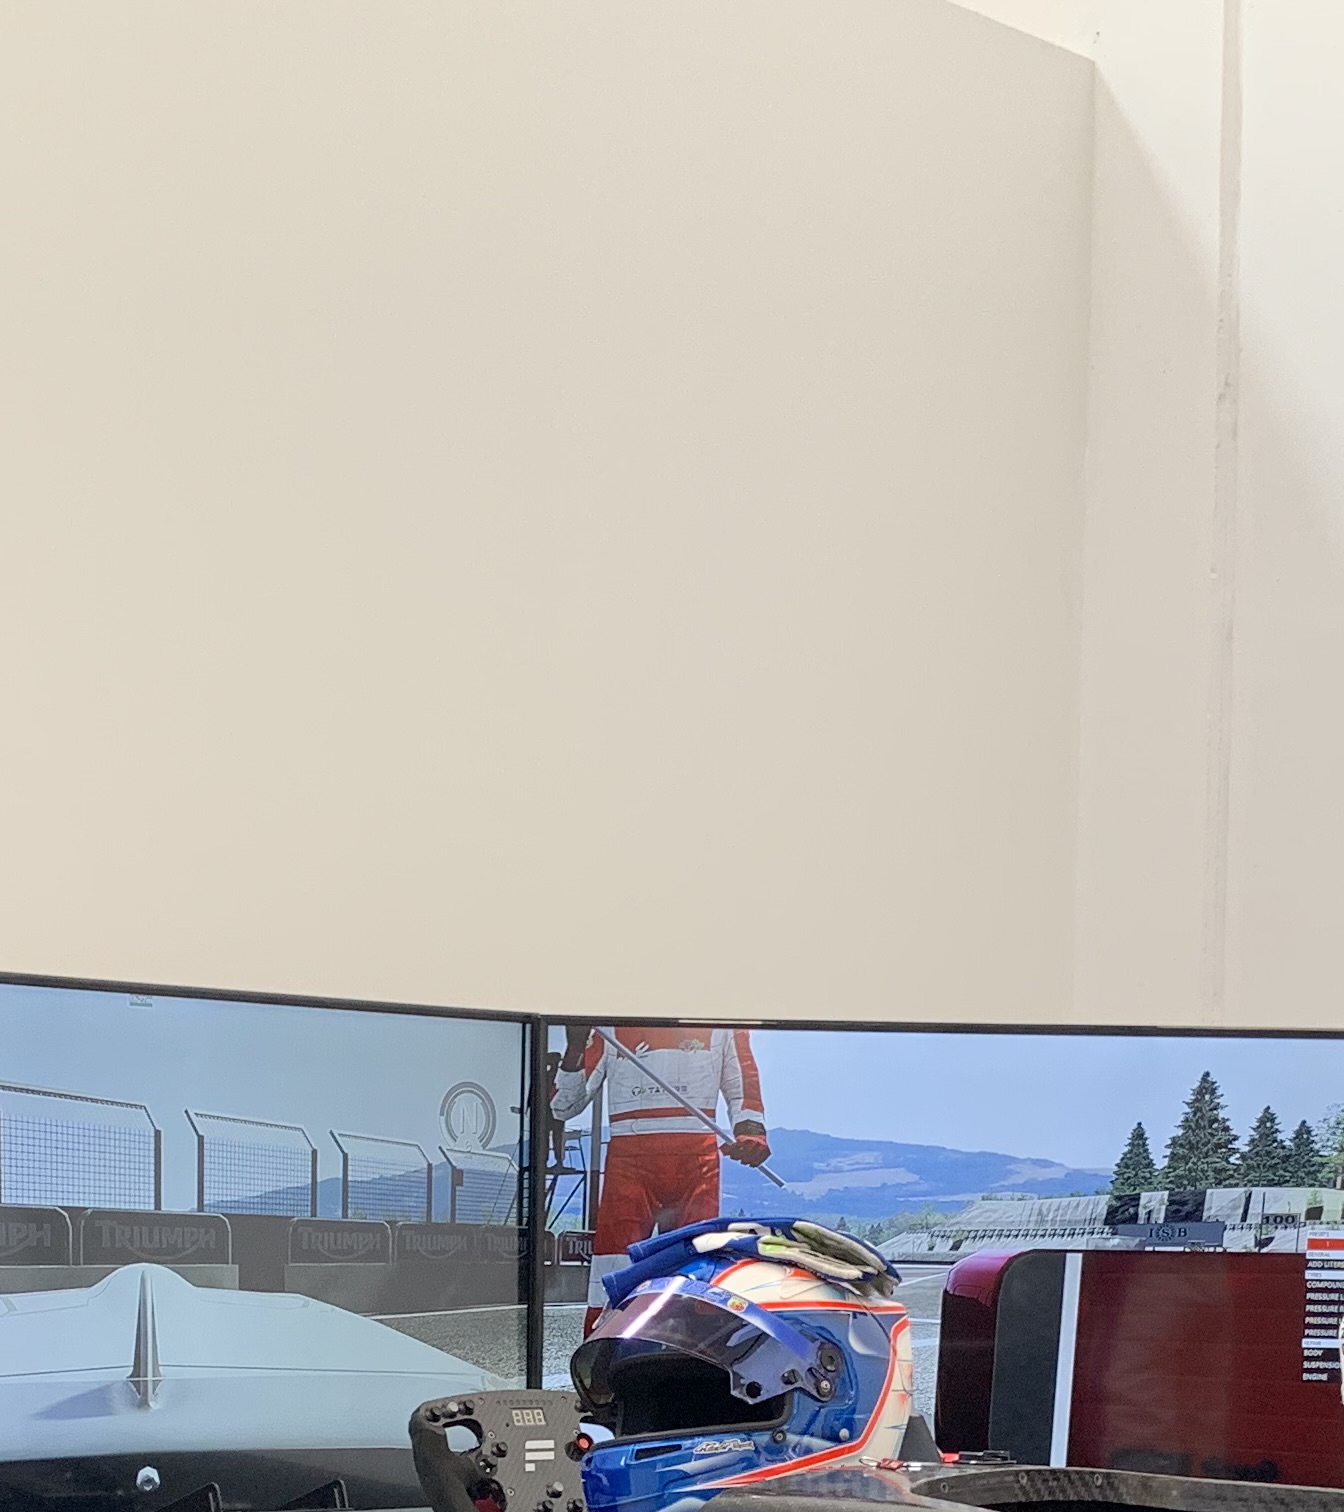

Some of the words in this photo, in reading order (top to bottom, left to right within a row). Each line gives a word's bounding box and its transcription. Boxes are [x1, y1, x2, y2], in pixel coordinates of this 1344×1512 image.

[1263, 1214, 1296, 1225] 100
[94, 1219, 217, 1254] TRIUMPH
[298, 1226, 382, 1254] TRIUMPH
[1306, 1292, 1339, 1301] PRESSURE
[1305, 1304, 1339, 1313] PRESSURE
[1304, 1316, 1338, 1325] PRESSURE
[1304, 1328, 1337, 1337] PRESSURE
[1303, 1349, 1324, 1357] BODY
[1303, 1361, 1341, 1369] SUSPENSIO
